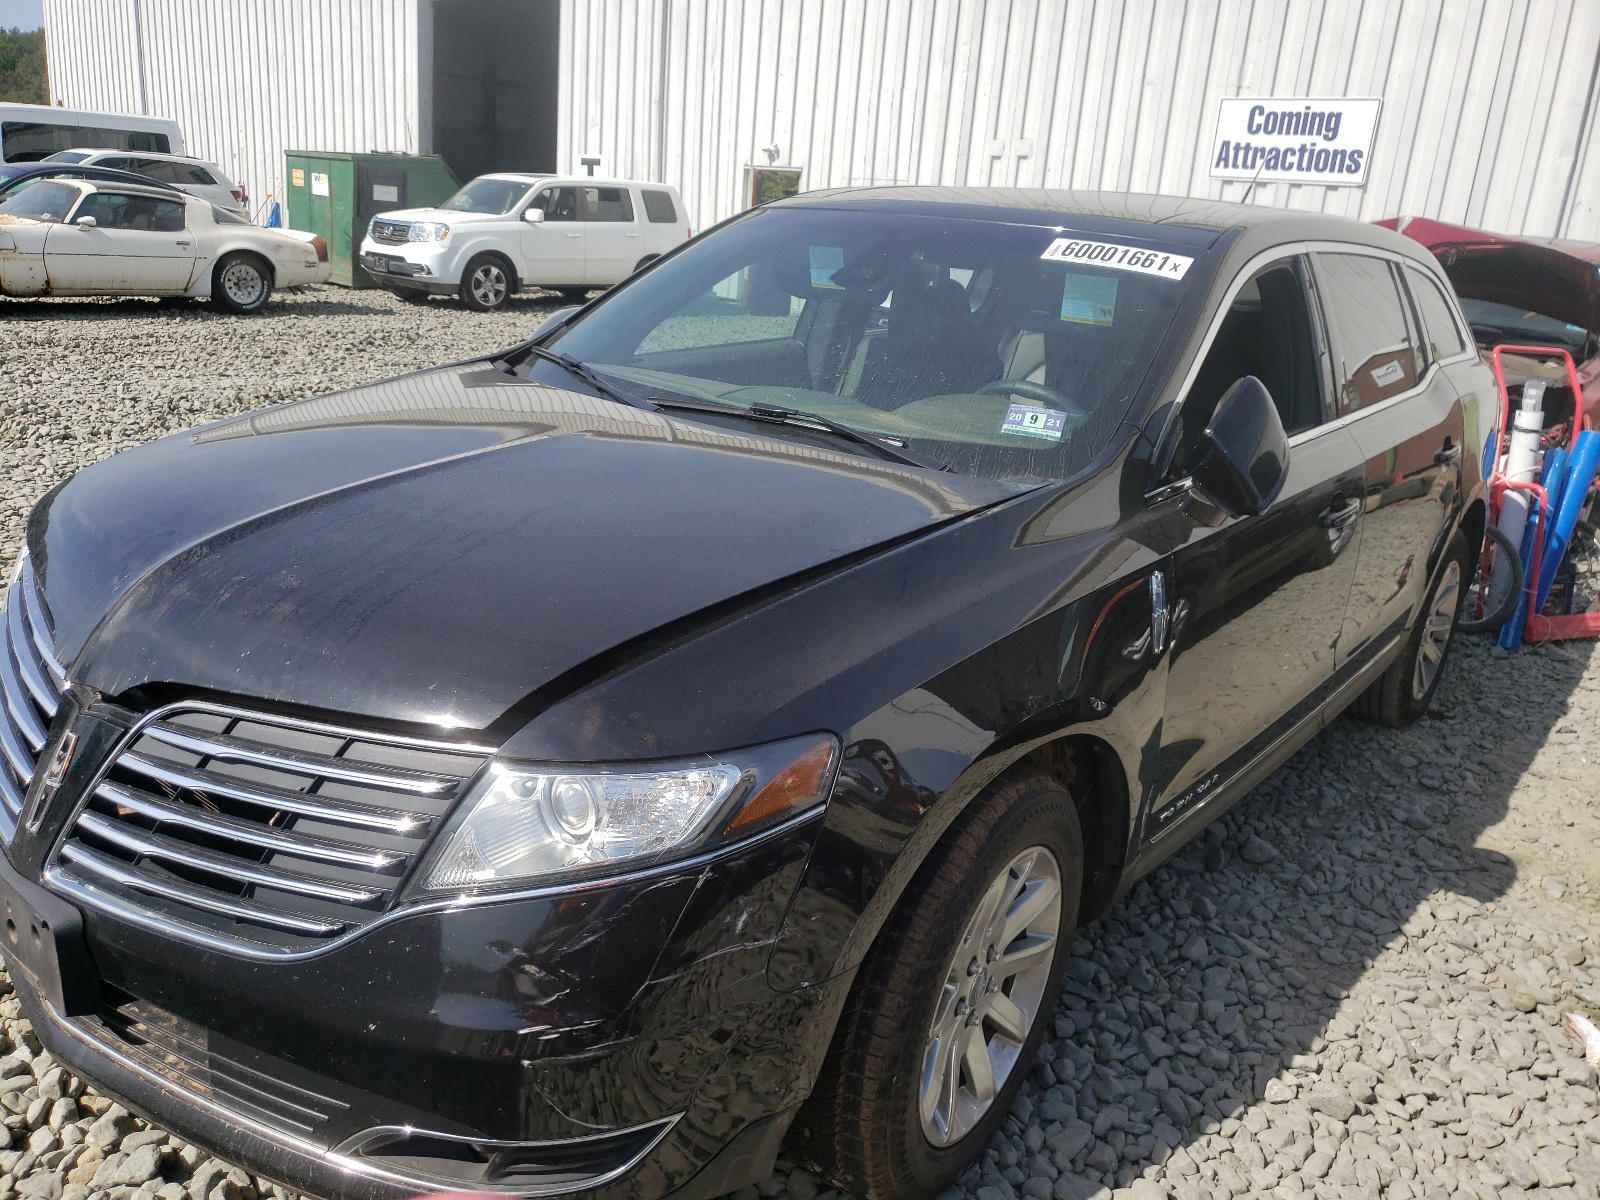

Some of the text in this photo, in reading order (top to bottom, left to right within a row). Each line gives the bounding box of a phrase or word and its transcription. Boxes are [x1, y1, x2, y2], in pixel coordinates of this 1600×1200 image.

[1247, 105, 1343, 142] Coming
[1214, 140, 1364, 174] Attractions
[1060, 241, 1171, 271] 60001661
[1008, 412, 1061, 427] 20 9 21
